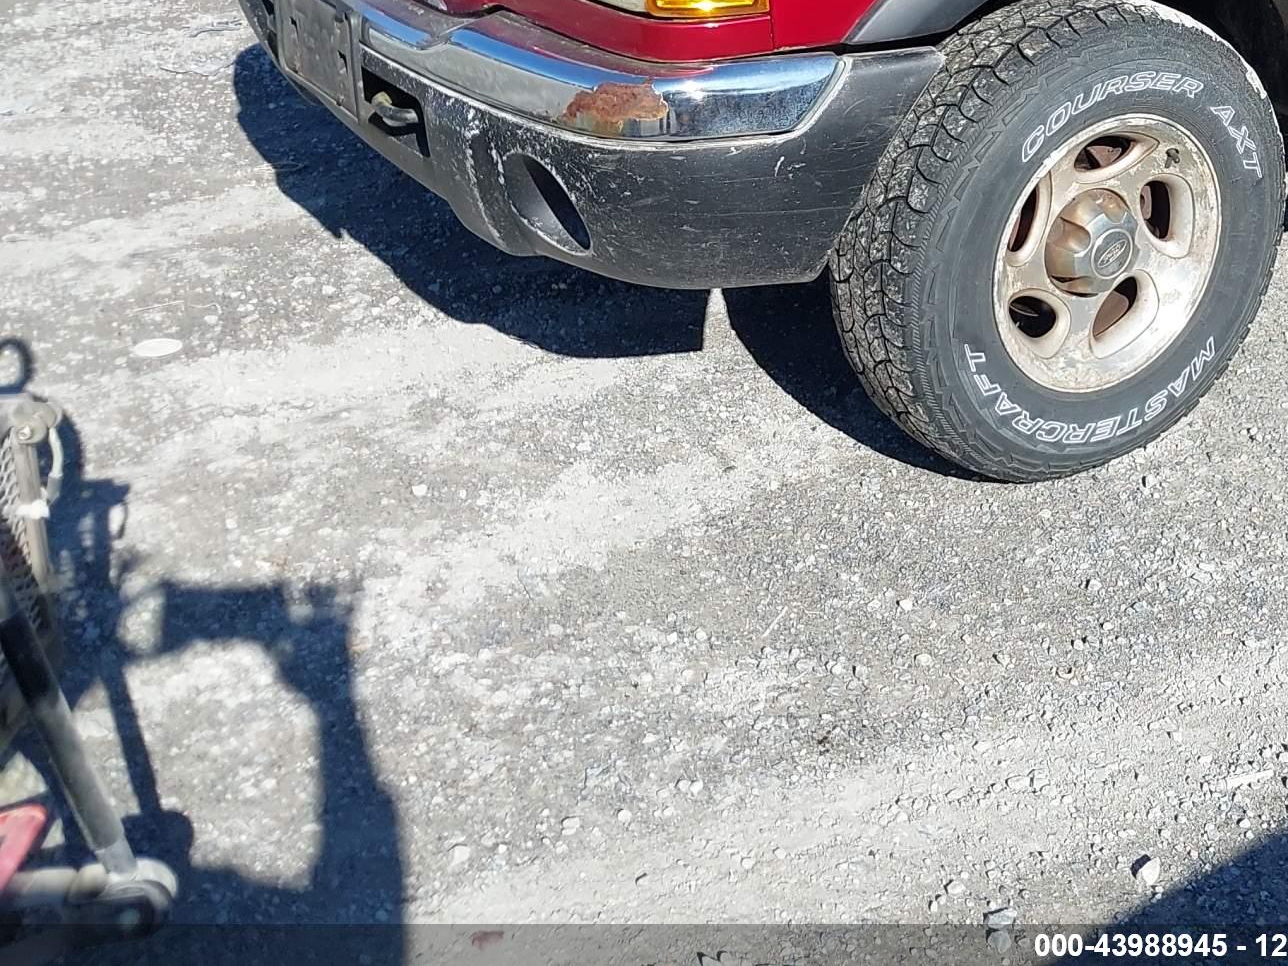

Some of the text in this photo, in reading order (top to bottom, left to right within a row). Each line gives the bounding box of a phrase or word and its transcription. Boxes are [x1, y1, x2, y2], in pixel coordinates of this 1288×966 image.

[1021, 70, 1263, 178] COURSER AXT
[964, 336, 1217, 444] MASTERCRAFT
